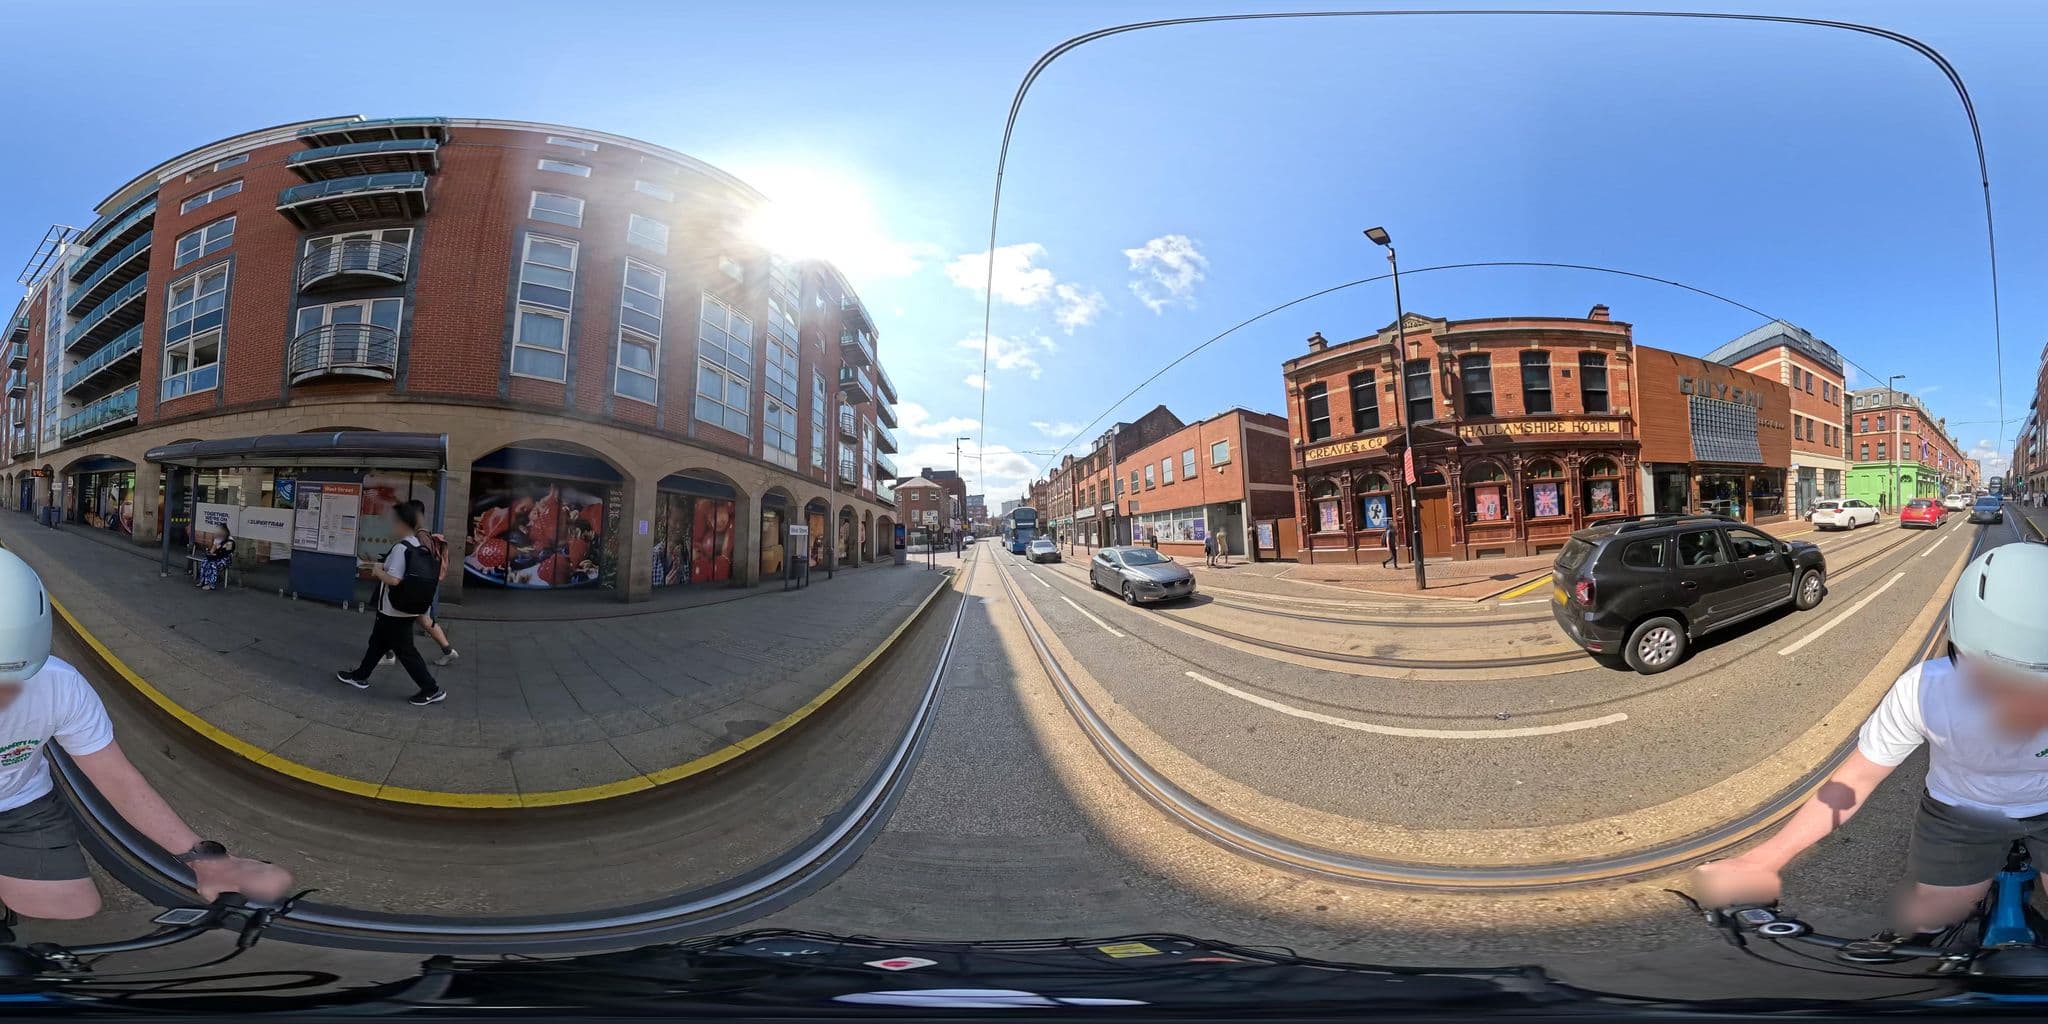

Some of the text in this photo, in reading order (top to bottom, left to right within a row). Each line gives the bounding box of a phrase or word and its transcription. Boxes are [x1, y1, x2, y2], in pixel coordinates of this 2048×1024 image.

[1466, 422, 1615, 437] HALLAMSHIRE HOTEL
[1309, 442, 1359, 459] GREAVES
